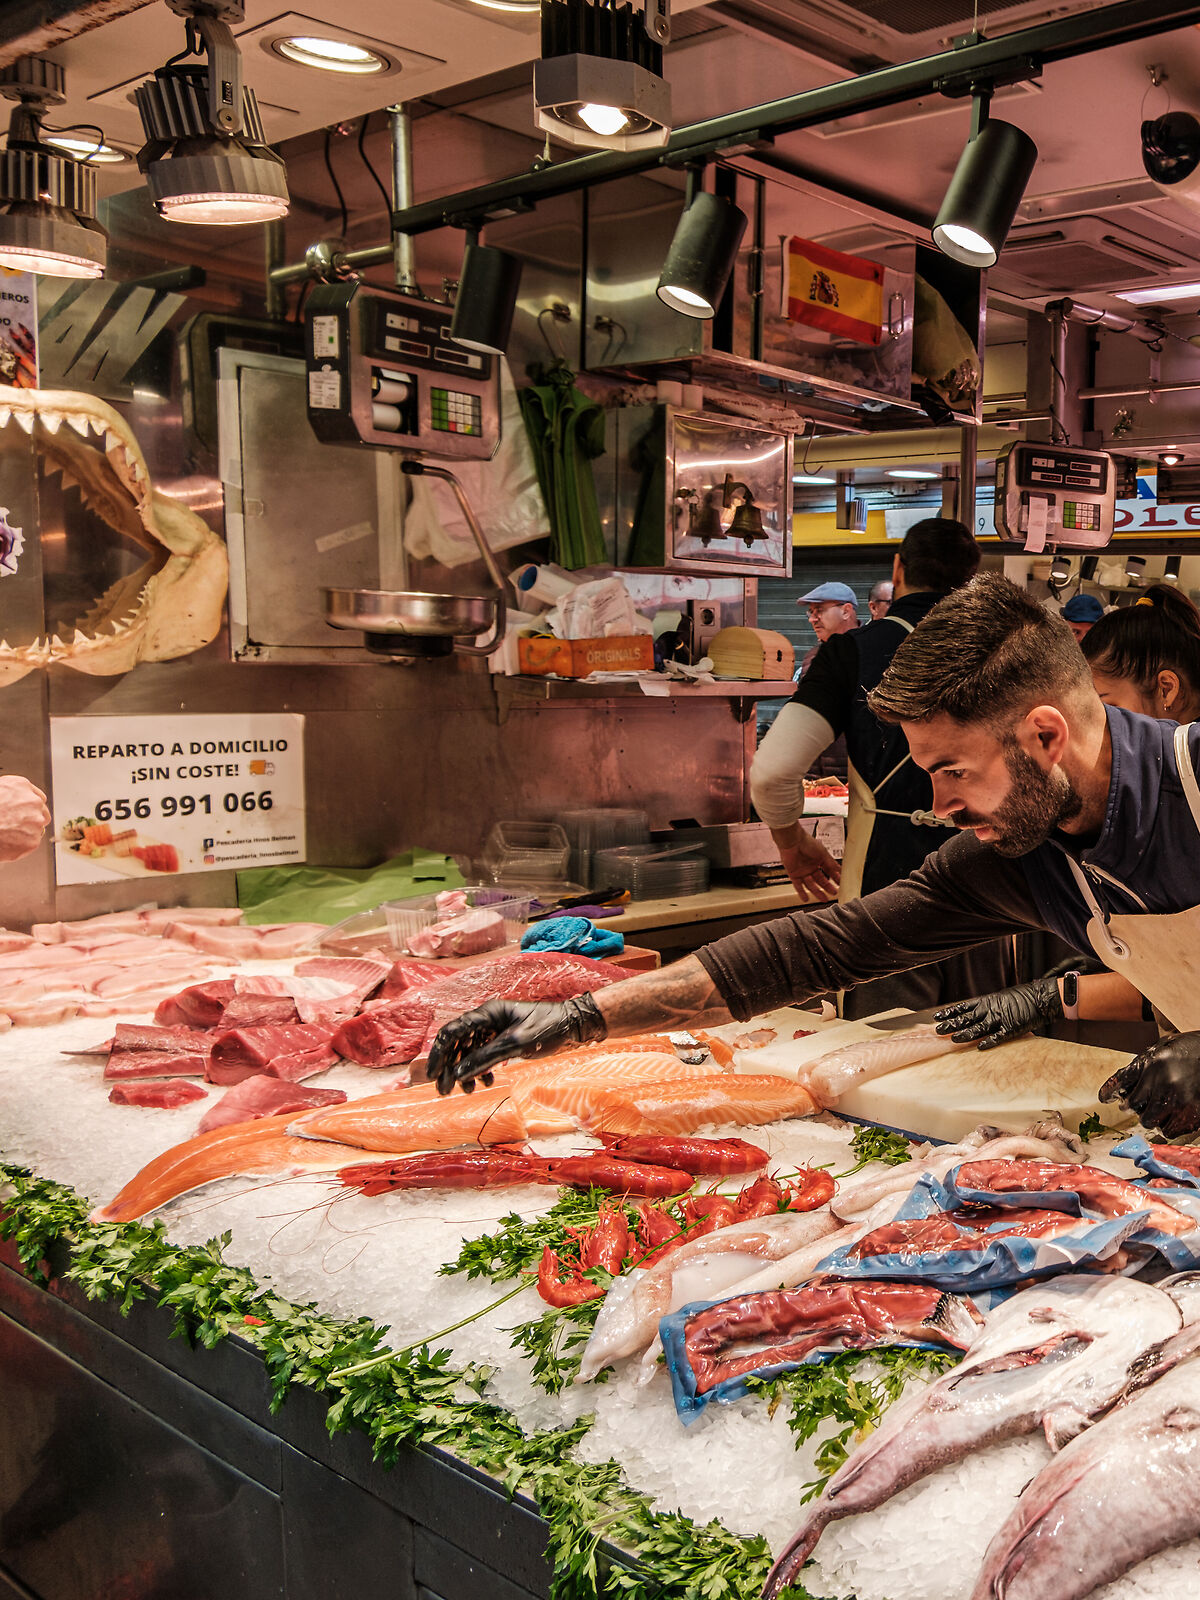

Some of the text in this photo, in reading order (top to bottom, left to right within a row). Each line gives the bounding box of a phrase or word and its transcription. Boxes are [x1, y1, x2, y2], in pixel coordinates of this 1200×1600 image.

[0, 291, 30, 304] EROS
[586, 647, 641, 664] ORIGINALS
[72, 739, 288, 759] REPARTO A DOMICILIO
[131, 764, 240, 784] ¡SIN COSTE!
[94, 790, 274, 822] 656 991 066
